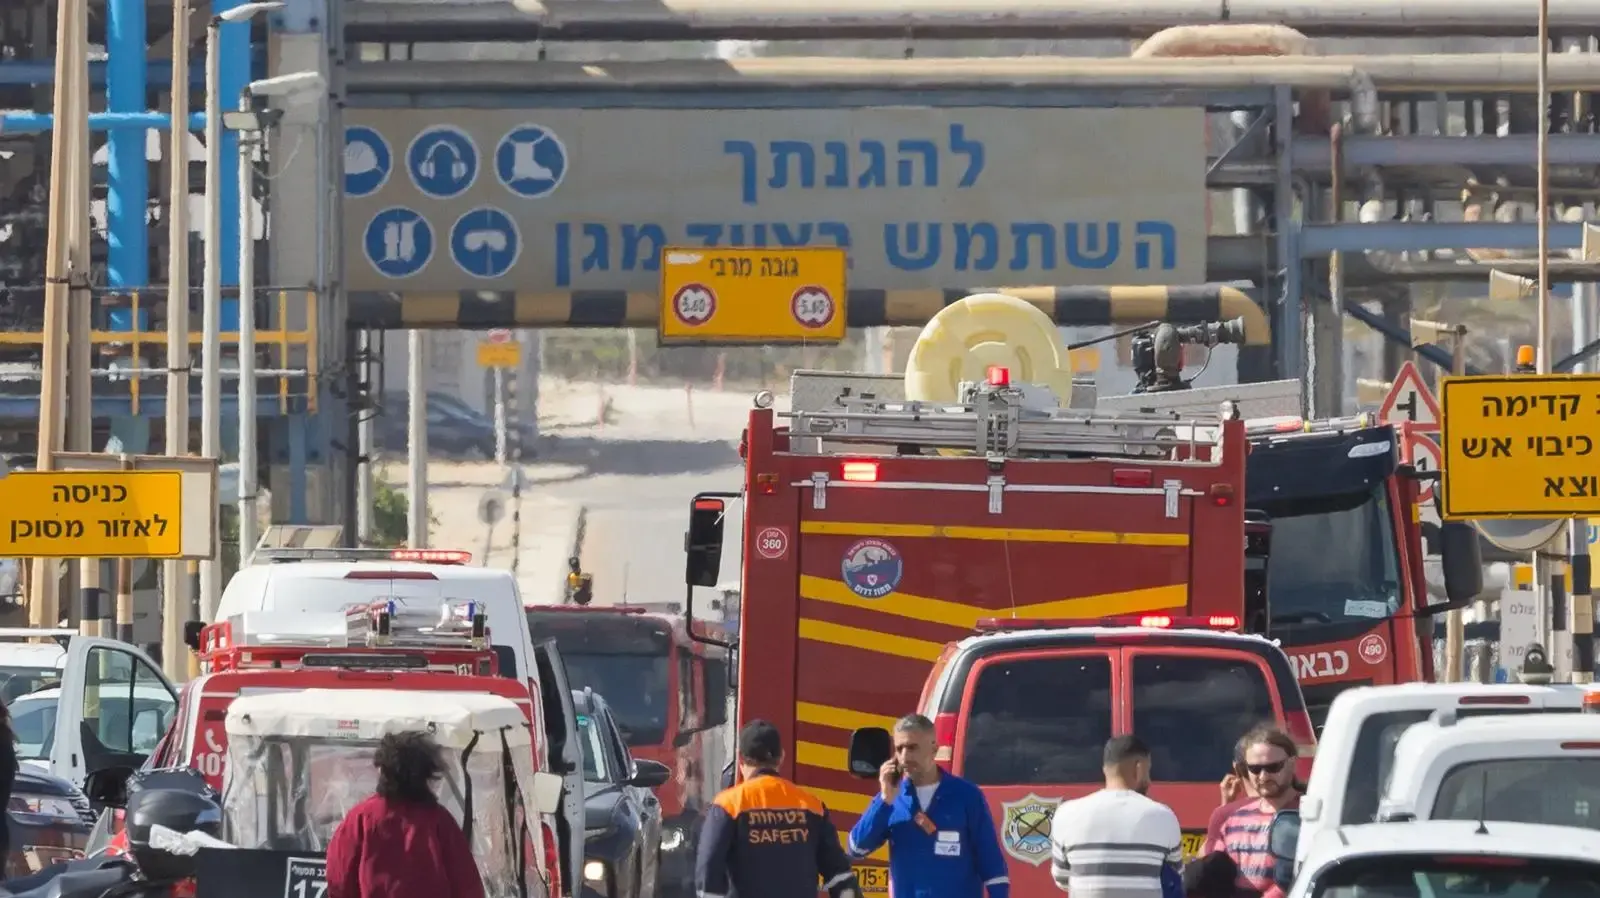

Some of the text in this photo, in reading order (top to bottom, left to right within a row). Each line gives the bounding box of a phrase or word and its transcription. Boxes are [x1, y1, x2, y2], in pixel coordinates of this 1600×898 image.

[724, 124, 985, 204] להגנתך
[555, 222, 667, 287] מגן
[884, 220, 1177, 271] השתמש
[710, 257, 800, 277] גובה מרבי
[1482, 394, 1581, 421] קדימה
[1461, 435, 1593, 459] כיבוי אש
[53, 484, 128, 503] כניסה
[10, 514, 168, 543] לאזור מסוכן
[762, 538, 782, 550] 360
[748, 810, 807, 825] בטיחות
[748, 828, 809, 845] SAFETY
